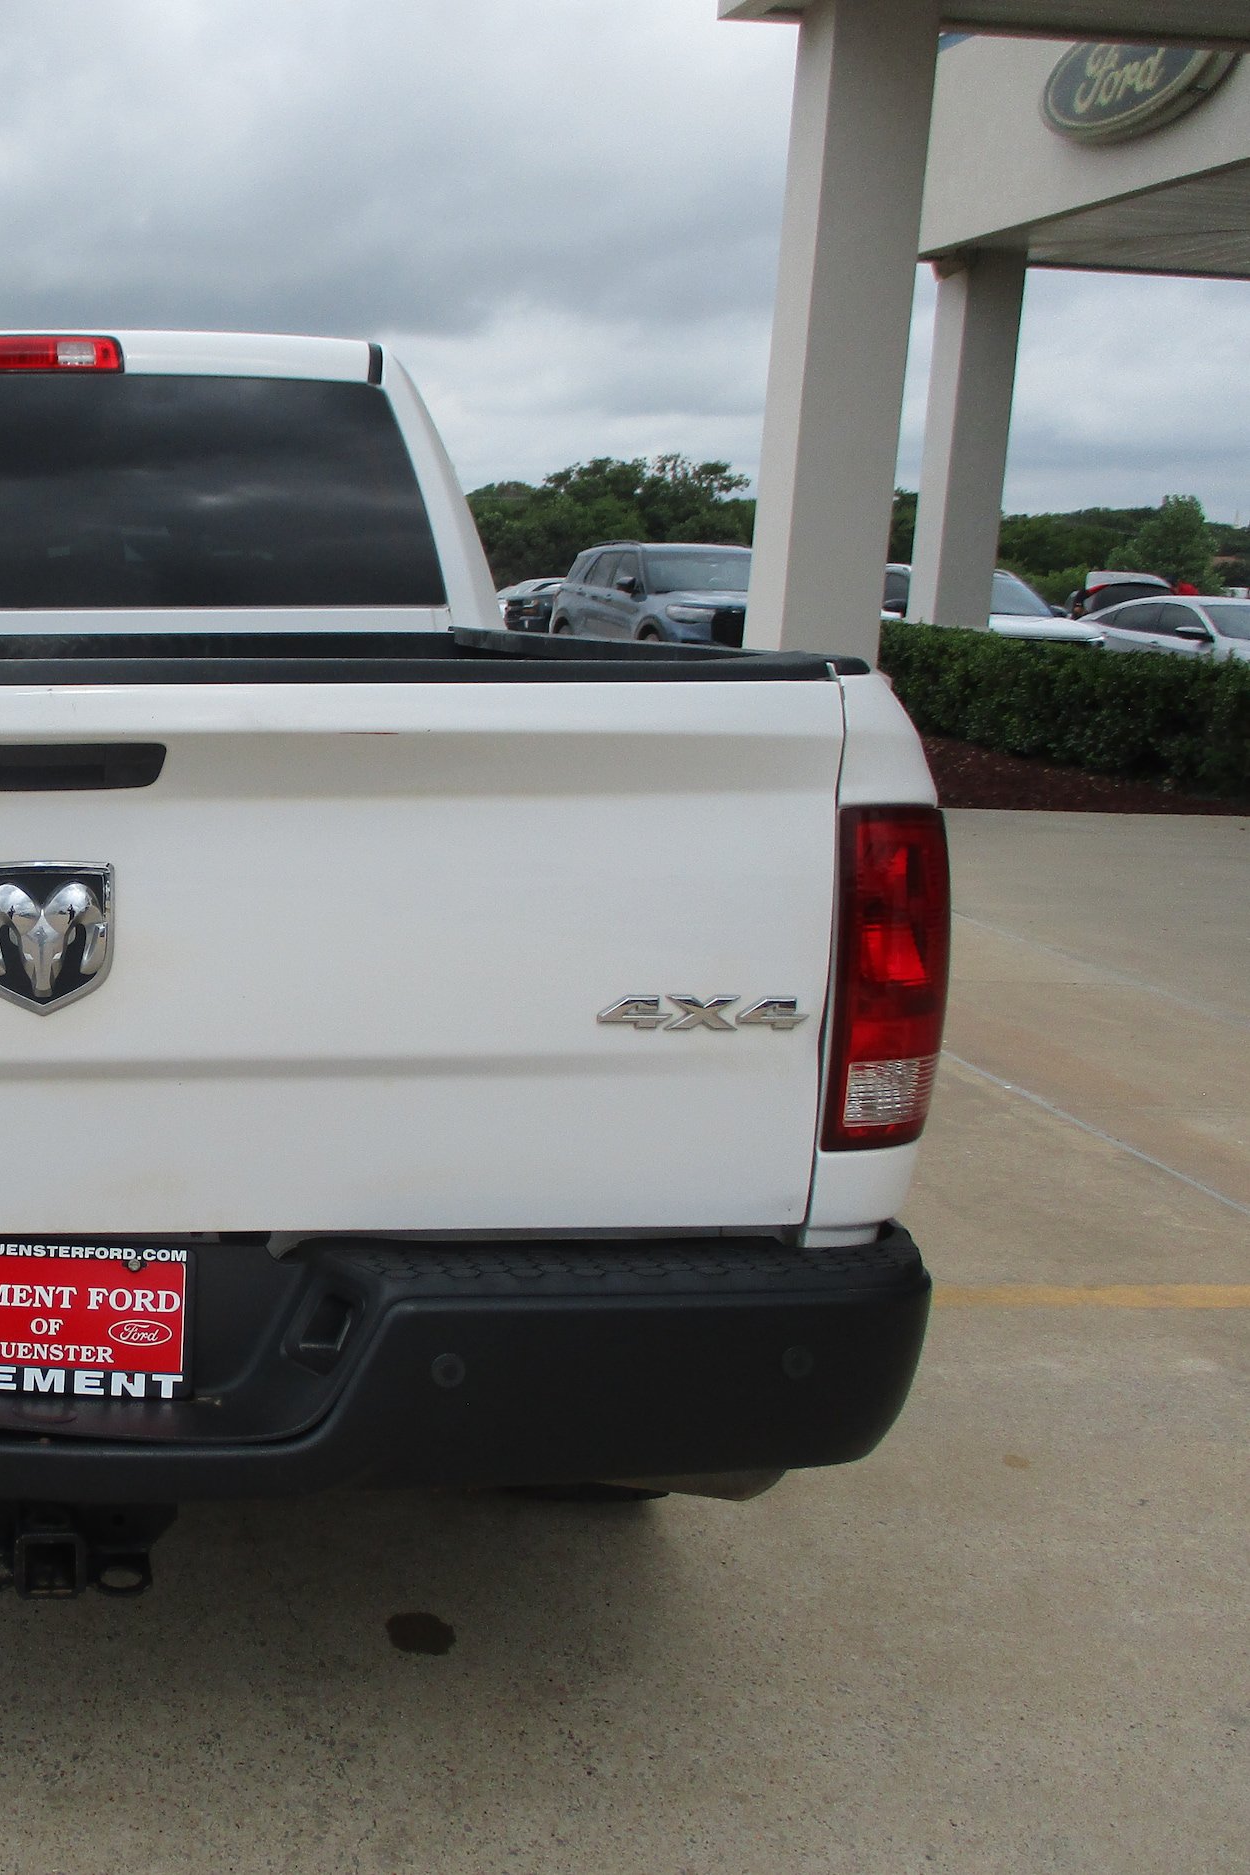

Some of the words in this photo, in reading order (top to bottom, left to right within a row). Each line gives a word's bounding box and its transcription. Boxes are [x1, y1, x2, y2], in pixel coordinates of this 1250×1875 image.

[1074, 44, 1165, 114] Ford
[86, 1287, 182, 1313] FORD
[29, 1317, 64, 1336] OF
[117, 1323, 161, 1343] Ford
